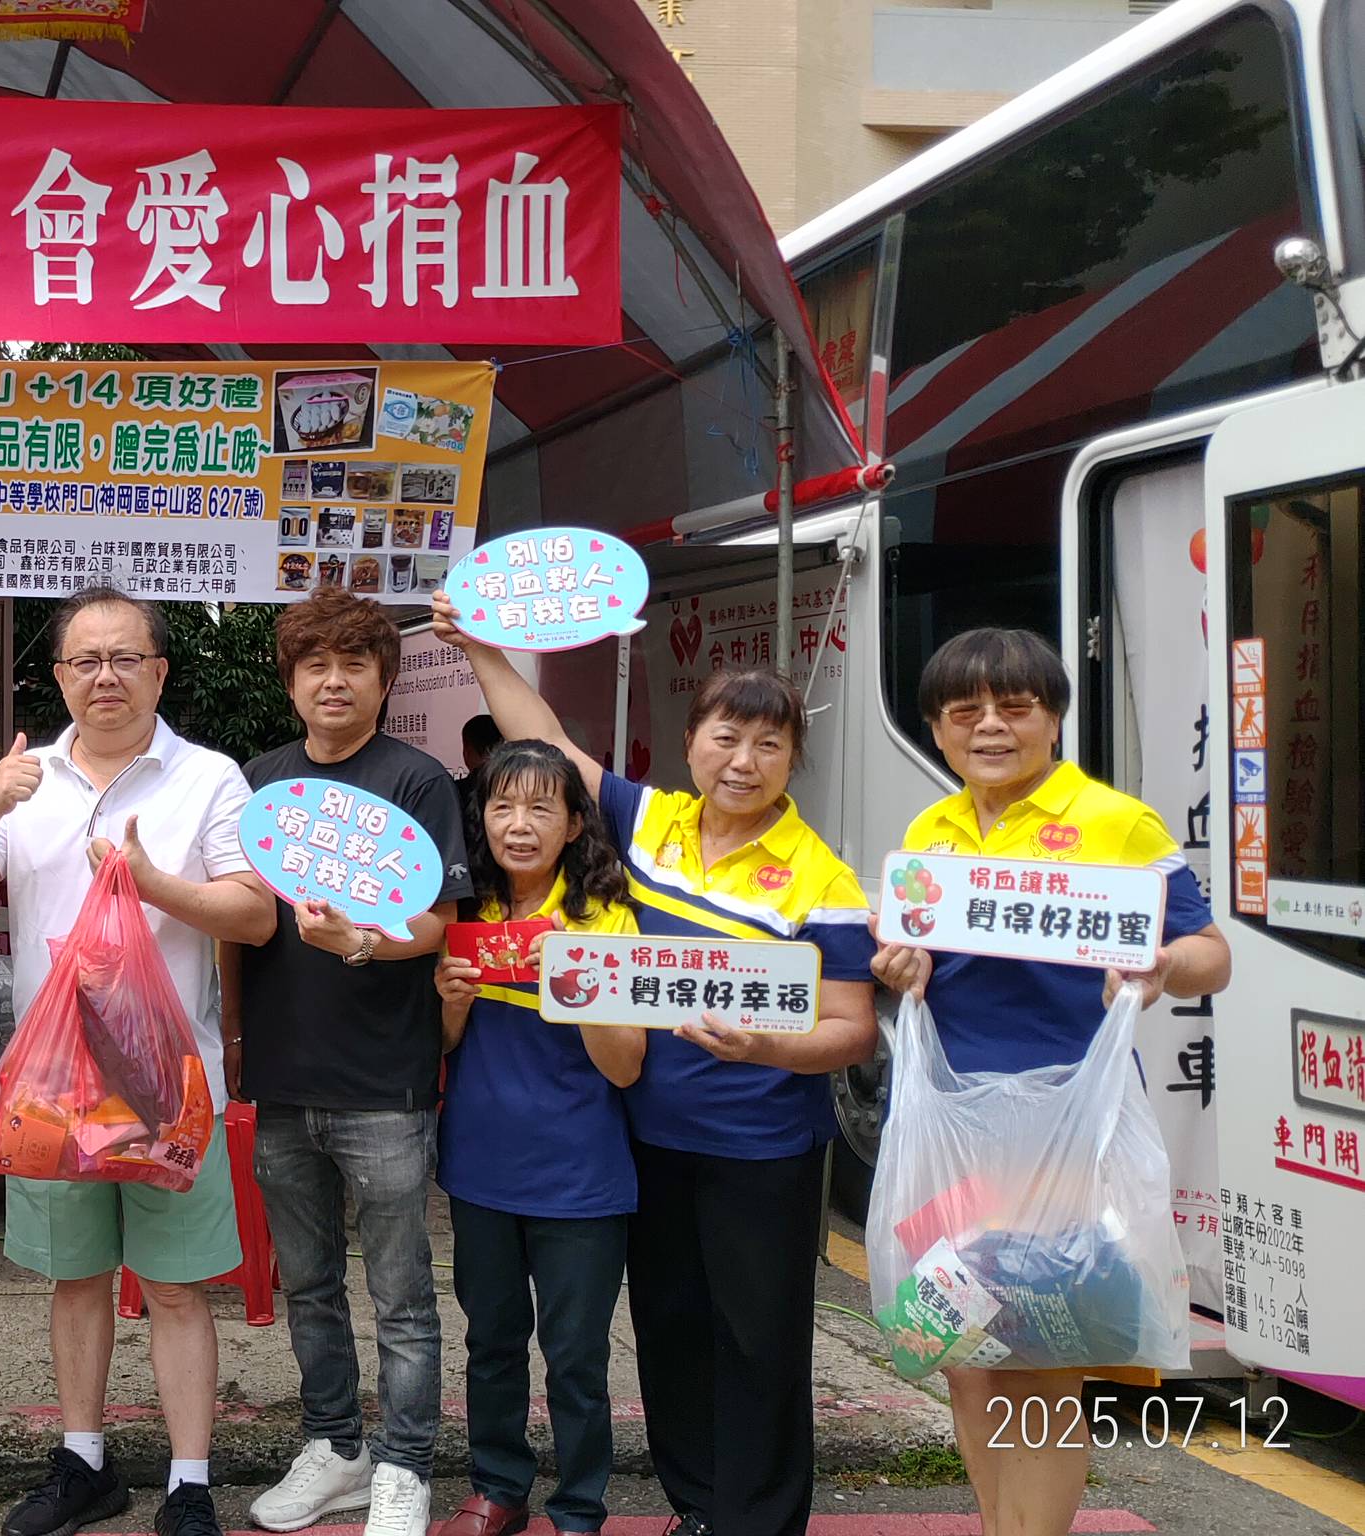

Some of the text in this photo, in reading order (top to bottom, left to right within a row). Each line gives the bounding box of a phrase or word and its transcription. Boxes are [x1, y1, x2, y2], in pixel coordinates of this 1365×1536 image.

[506, 535, 574, 567] 別怕
[476, 563, 614, 600] 捐血救人
[497, 594, 602, 629] 有我在
[708, 617, 847, 671] 台中捐中心
[456, 669, 476, 687] Taiwa
[822, 664, 843, 678] TBS
[319, 786, 389, 836] 別怕
[277, 805, 407, 880] 捐血救人
[282, 842, 384, 906] 有我在
[966, 897, 1152, 949] 覺得好甜蜜
[629, 975, 810, 1014] 覺得好幸福
[1273, 1115, 1361, 1177] 車門開
[1220, 1187, 1303, 1231] 甲類大客車
[1224, 1259, 1309, 1308] 座位 7 人
